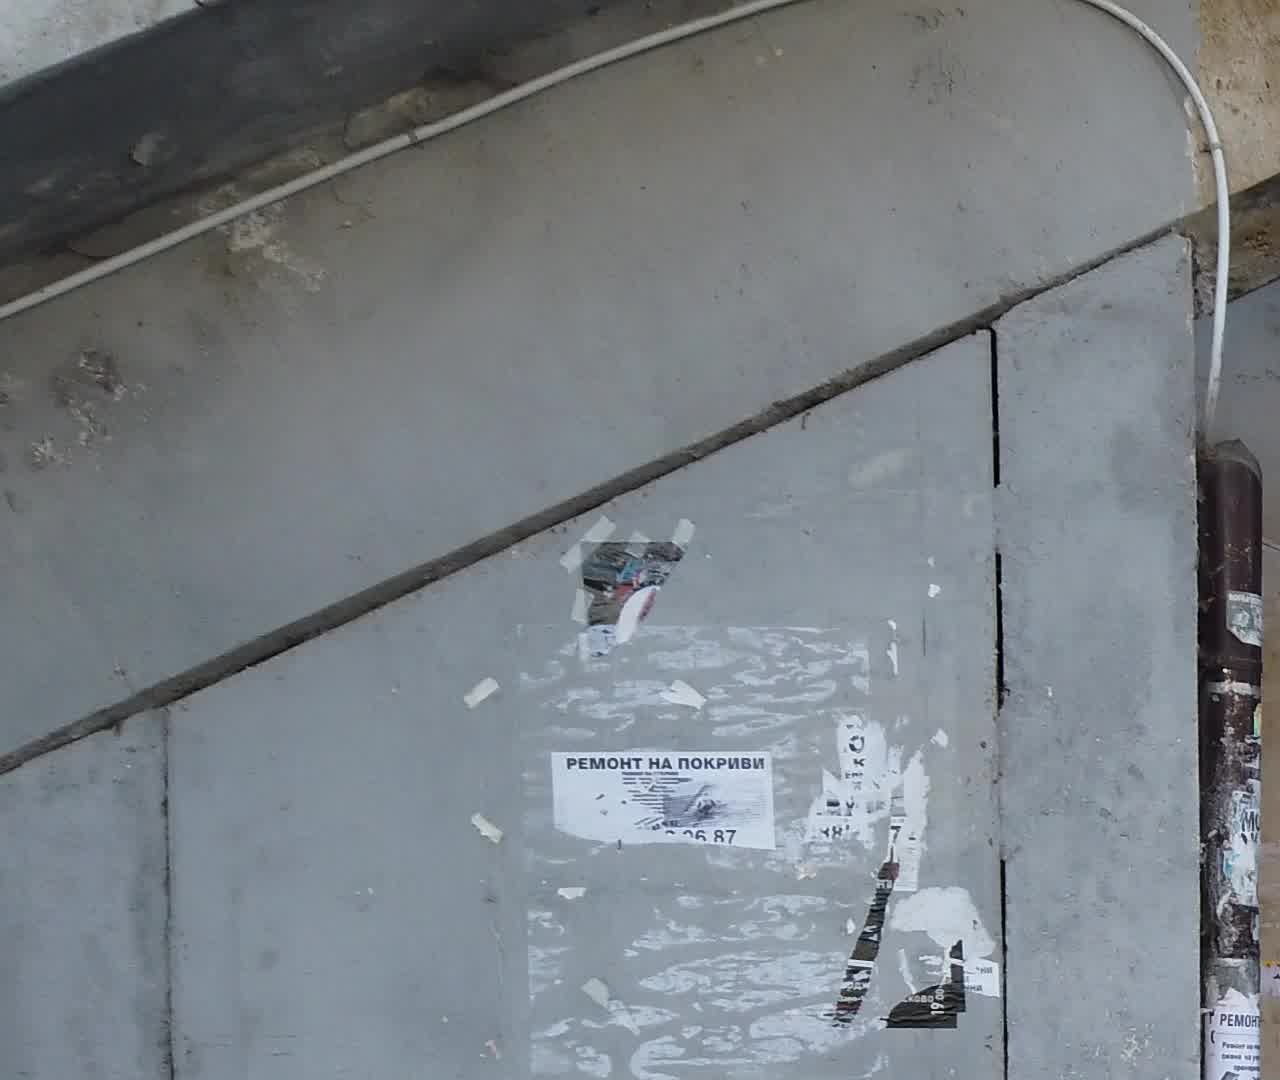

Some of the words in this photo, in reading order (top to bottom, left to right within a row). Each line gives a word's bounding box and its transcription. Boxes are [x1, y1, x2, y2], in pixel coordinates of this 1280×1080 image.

[566, 758, 643, 770] РЕМОНТ
[648, 758, 673, 770] НА
[678, 758, 765, 770] ПОКРИВИ
